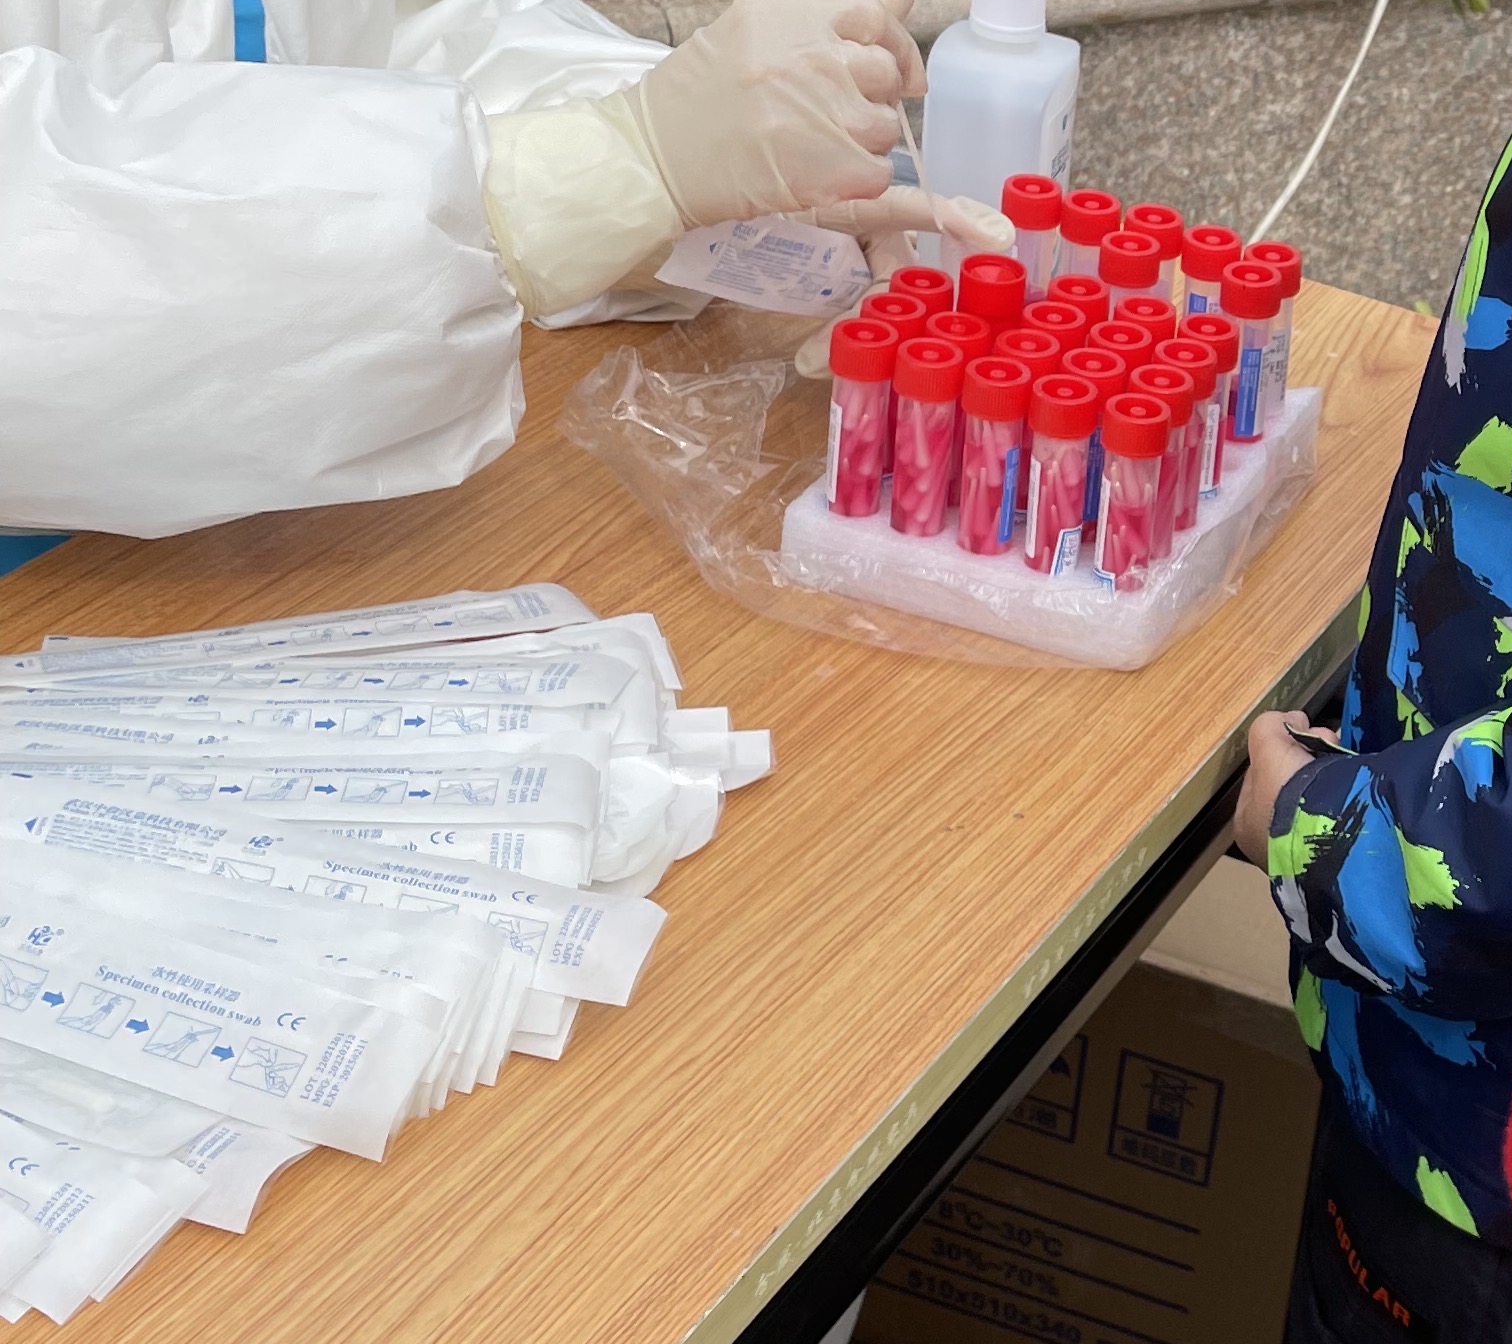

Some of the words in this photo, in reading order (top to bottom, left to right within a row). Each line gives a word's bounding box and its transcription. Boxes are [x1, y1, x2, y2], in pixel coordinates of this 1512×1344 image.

[323, 860, 390, 882] Specimen
[392, 875, 459, 896] collection
[461, 888, 497, 903] swab
[96, 965, 160, 995] Specimen
[161, 988, 225, 1016] collection
[227, 1007, 262, 1027] swab
